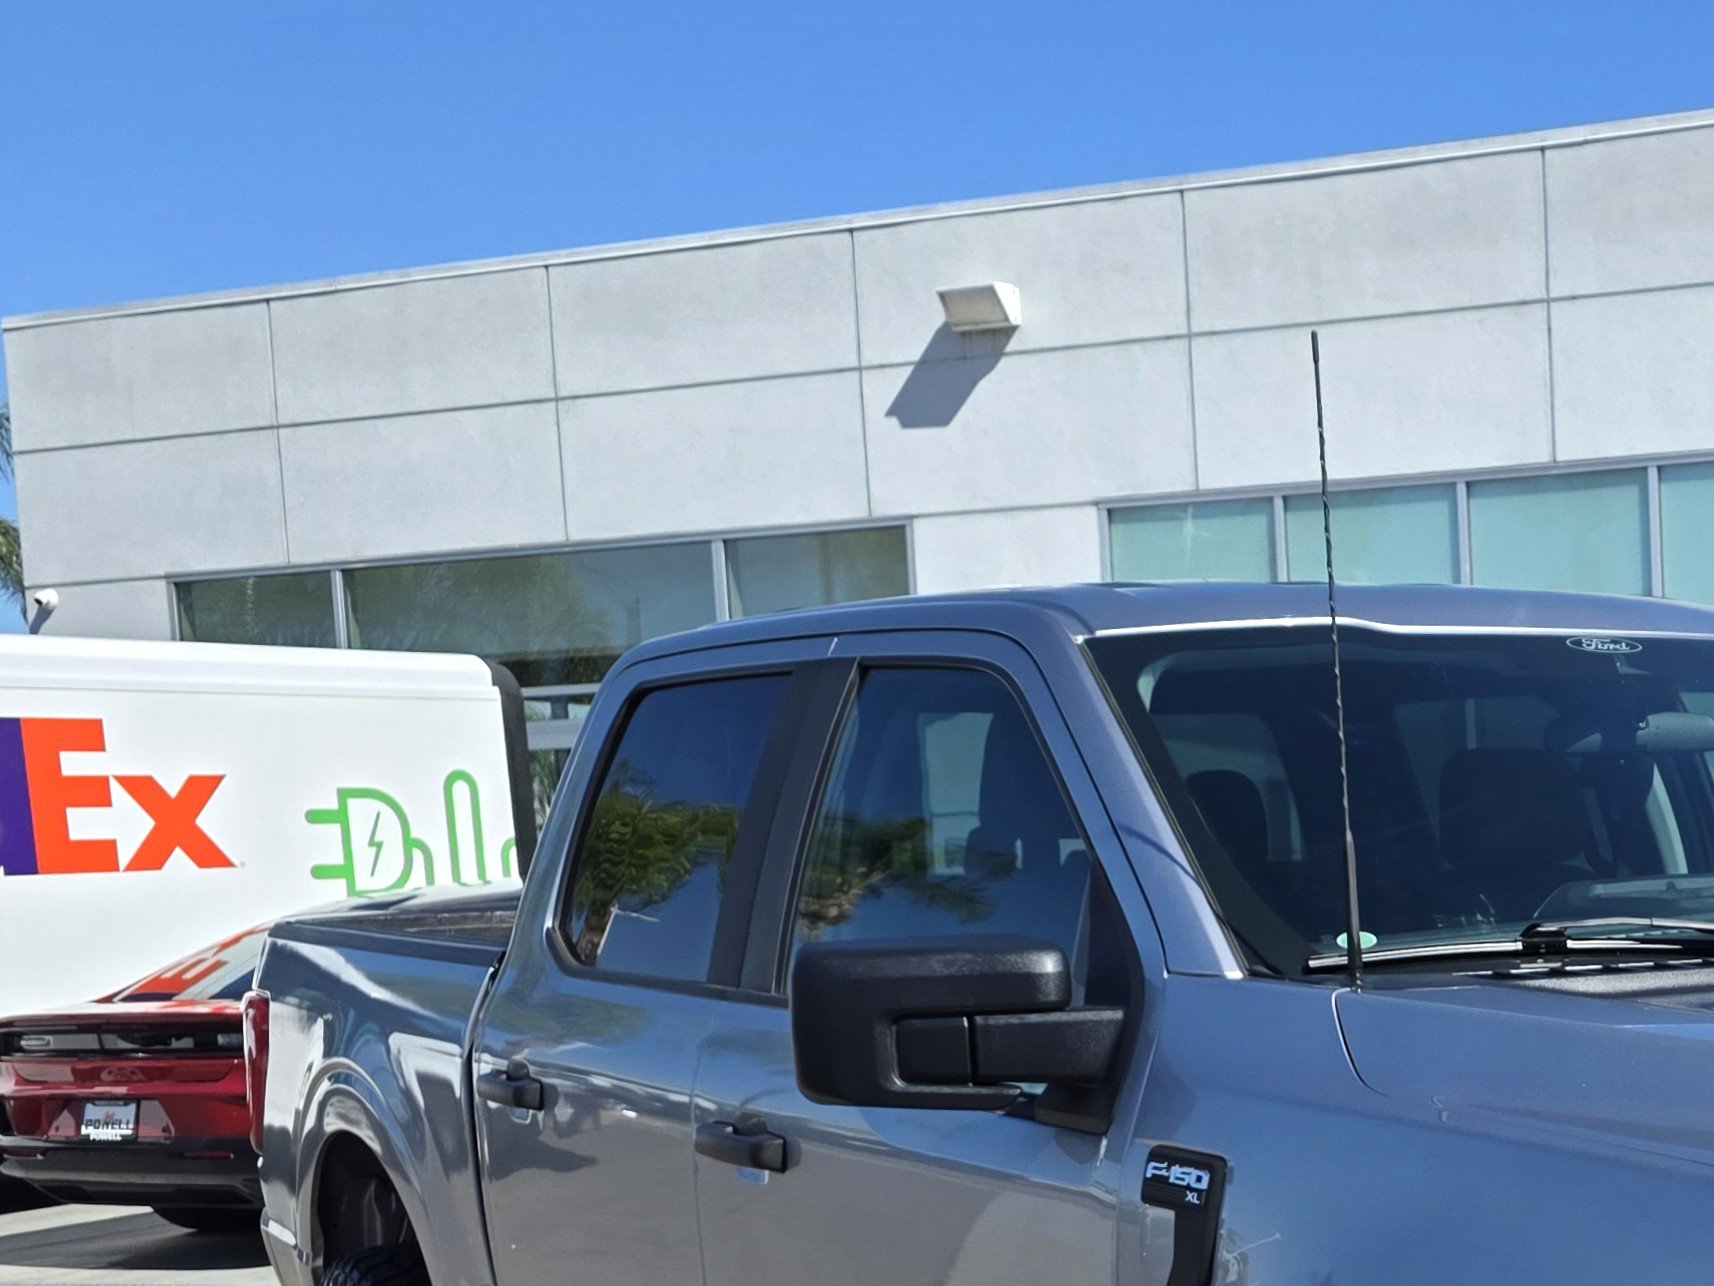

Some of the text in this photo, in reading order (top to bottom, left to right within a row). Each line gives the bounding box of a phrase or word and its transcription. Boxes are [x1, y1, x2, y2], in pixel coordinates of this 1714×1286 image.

[1581, 637, 1631, 651] Ford
[1145, 1161, 1211, 1190] F-150
[1184, 1190, 1201, 1204] XL
